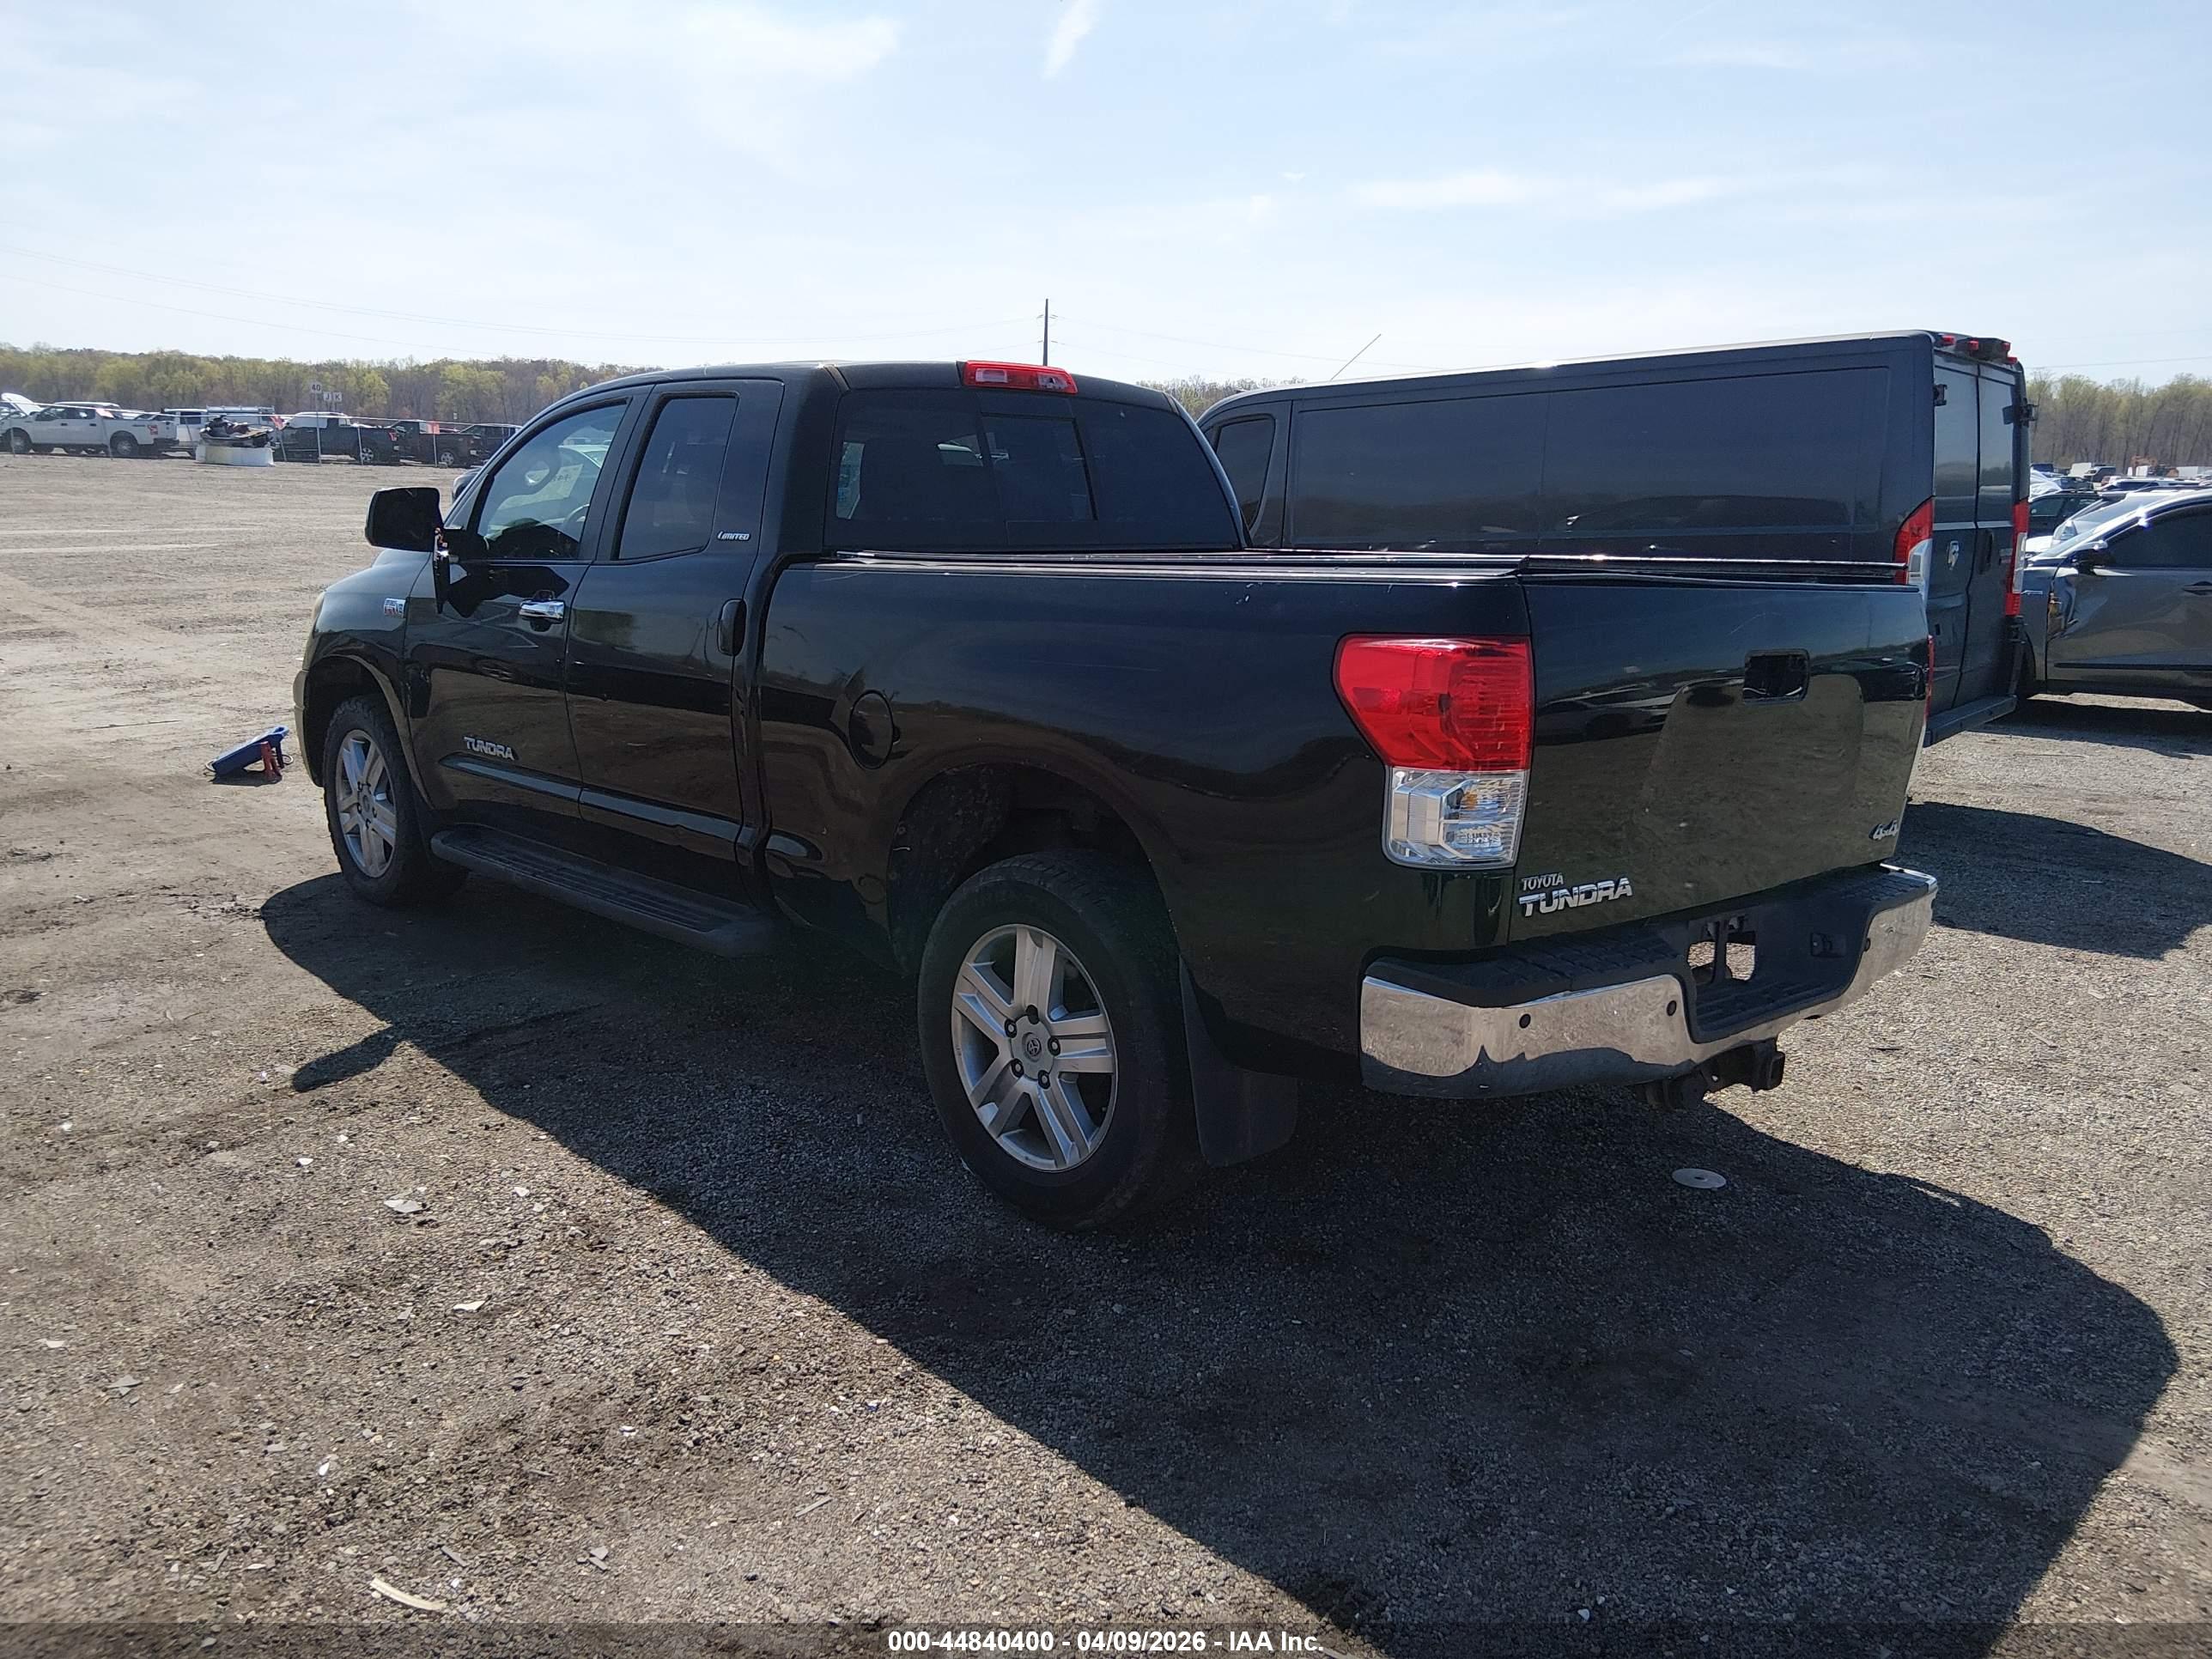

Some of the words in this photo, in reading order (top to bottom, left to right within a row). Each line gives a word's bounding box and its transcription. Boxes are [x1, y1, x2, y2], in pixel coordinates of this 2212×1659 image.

[464, 736, 515, 761] TUNDRA
[1522, 872, 1564, 891] TOYOTA
[1518, 877, 1632, 917] TUNDRA
